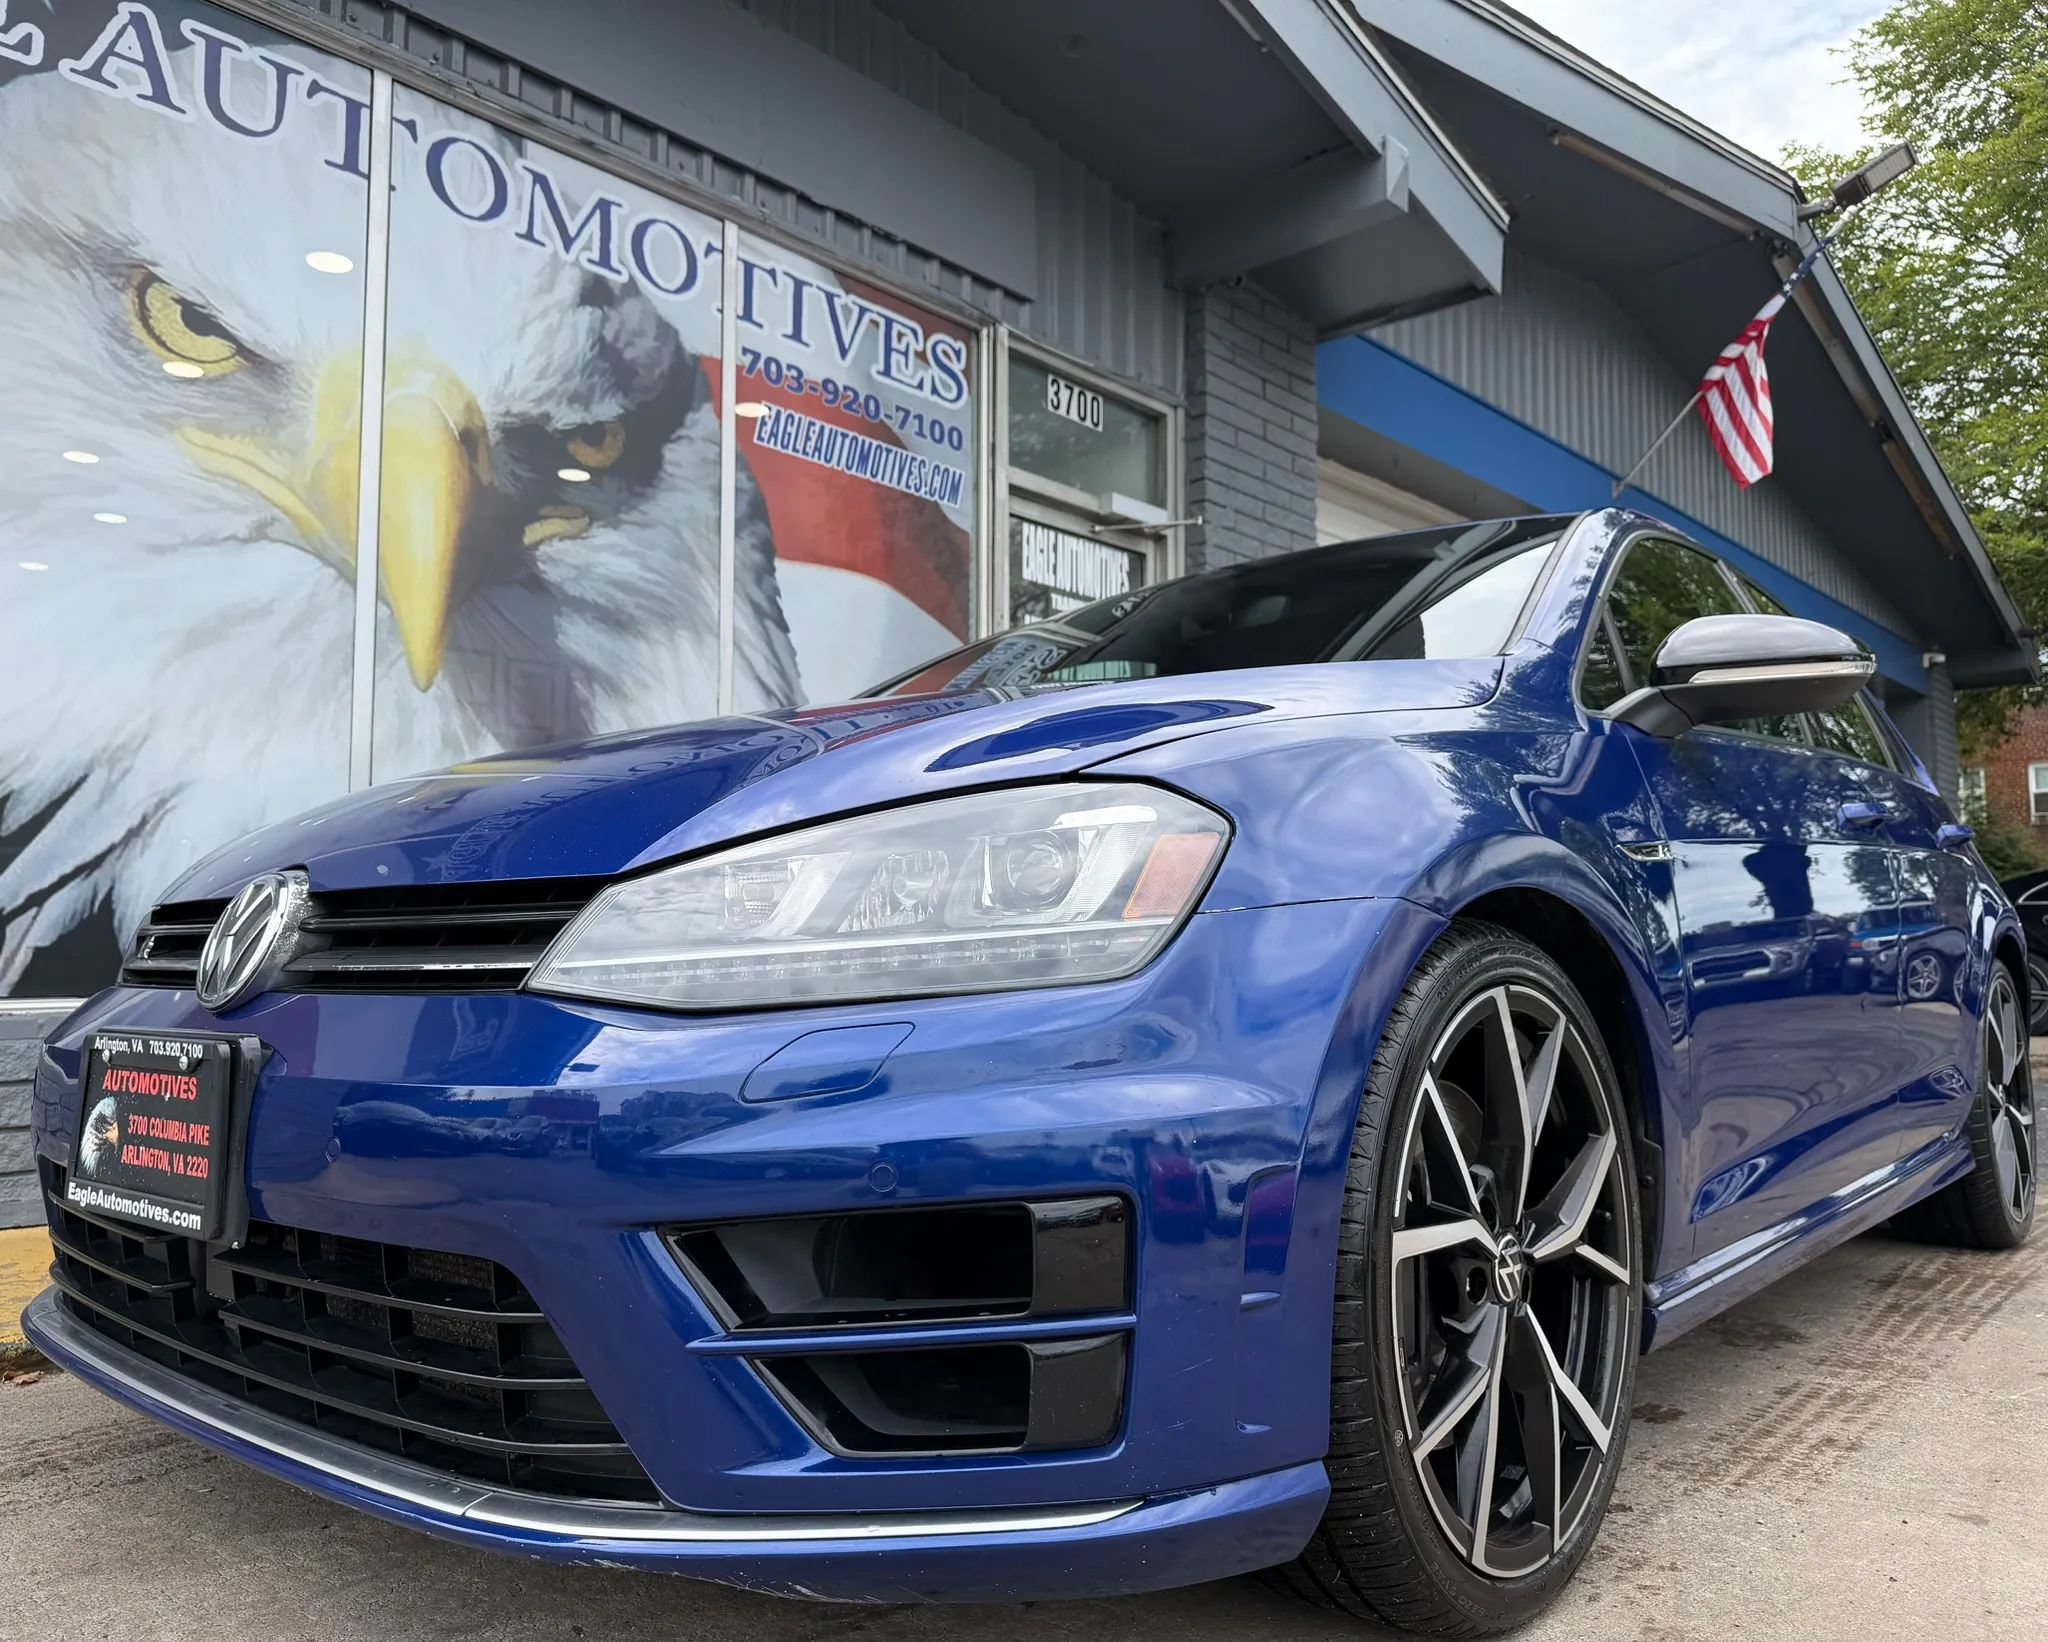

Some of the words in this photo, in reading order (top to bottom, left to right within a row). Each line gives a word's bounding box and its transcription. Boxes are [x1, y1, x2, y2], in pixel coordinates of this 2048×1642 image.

[66, 9, 967, 404] AUTOMOTIVES
[740, 346, 965, 450] 703-920-7100
[1050, 378, 1101, 428] 3700
[755, 403, 965, 506] EAGLEAUTOMOTIVES.COM
[94, 1036, 130, 1054] Arlington,
[131, 1039, 144, 1053] VA
[149, 1040, 203, 1058] 703.920.7100
[102, 1069, 197, 1100] AUTOMOTIVES
[128, 1114, 148, 1136] 3700
[149, 1117, 187, 1143] COLUMBIA
[189, 1123, 210, 1146] PIKE
[121, 1144, 171, 1176] ARLINGTON,
[173, 1152, 185, 1174] VA
[186, 1155, 209, 1178] 2220
[68, 1182, 201, 1230] EagleAutomotives.com
